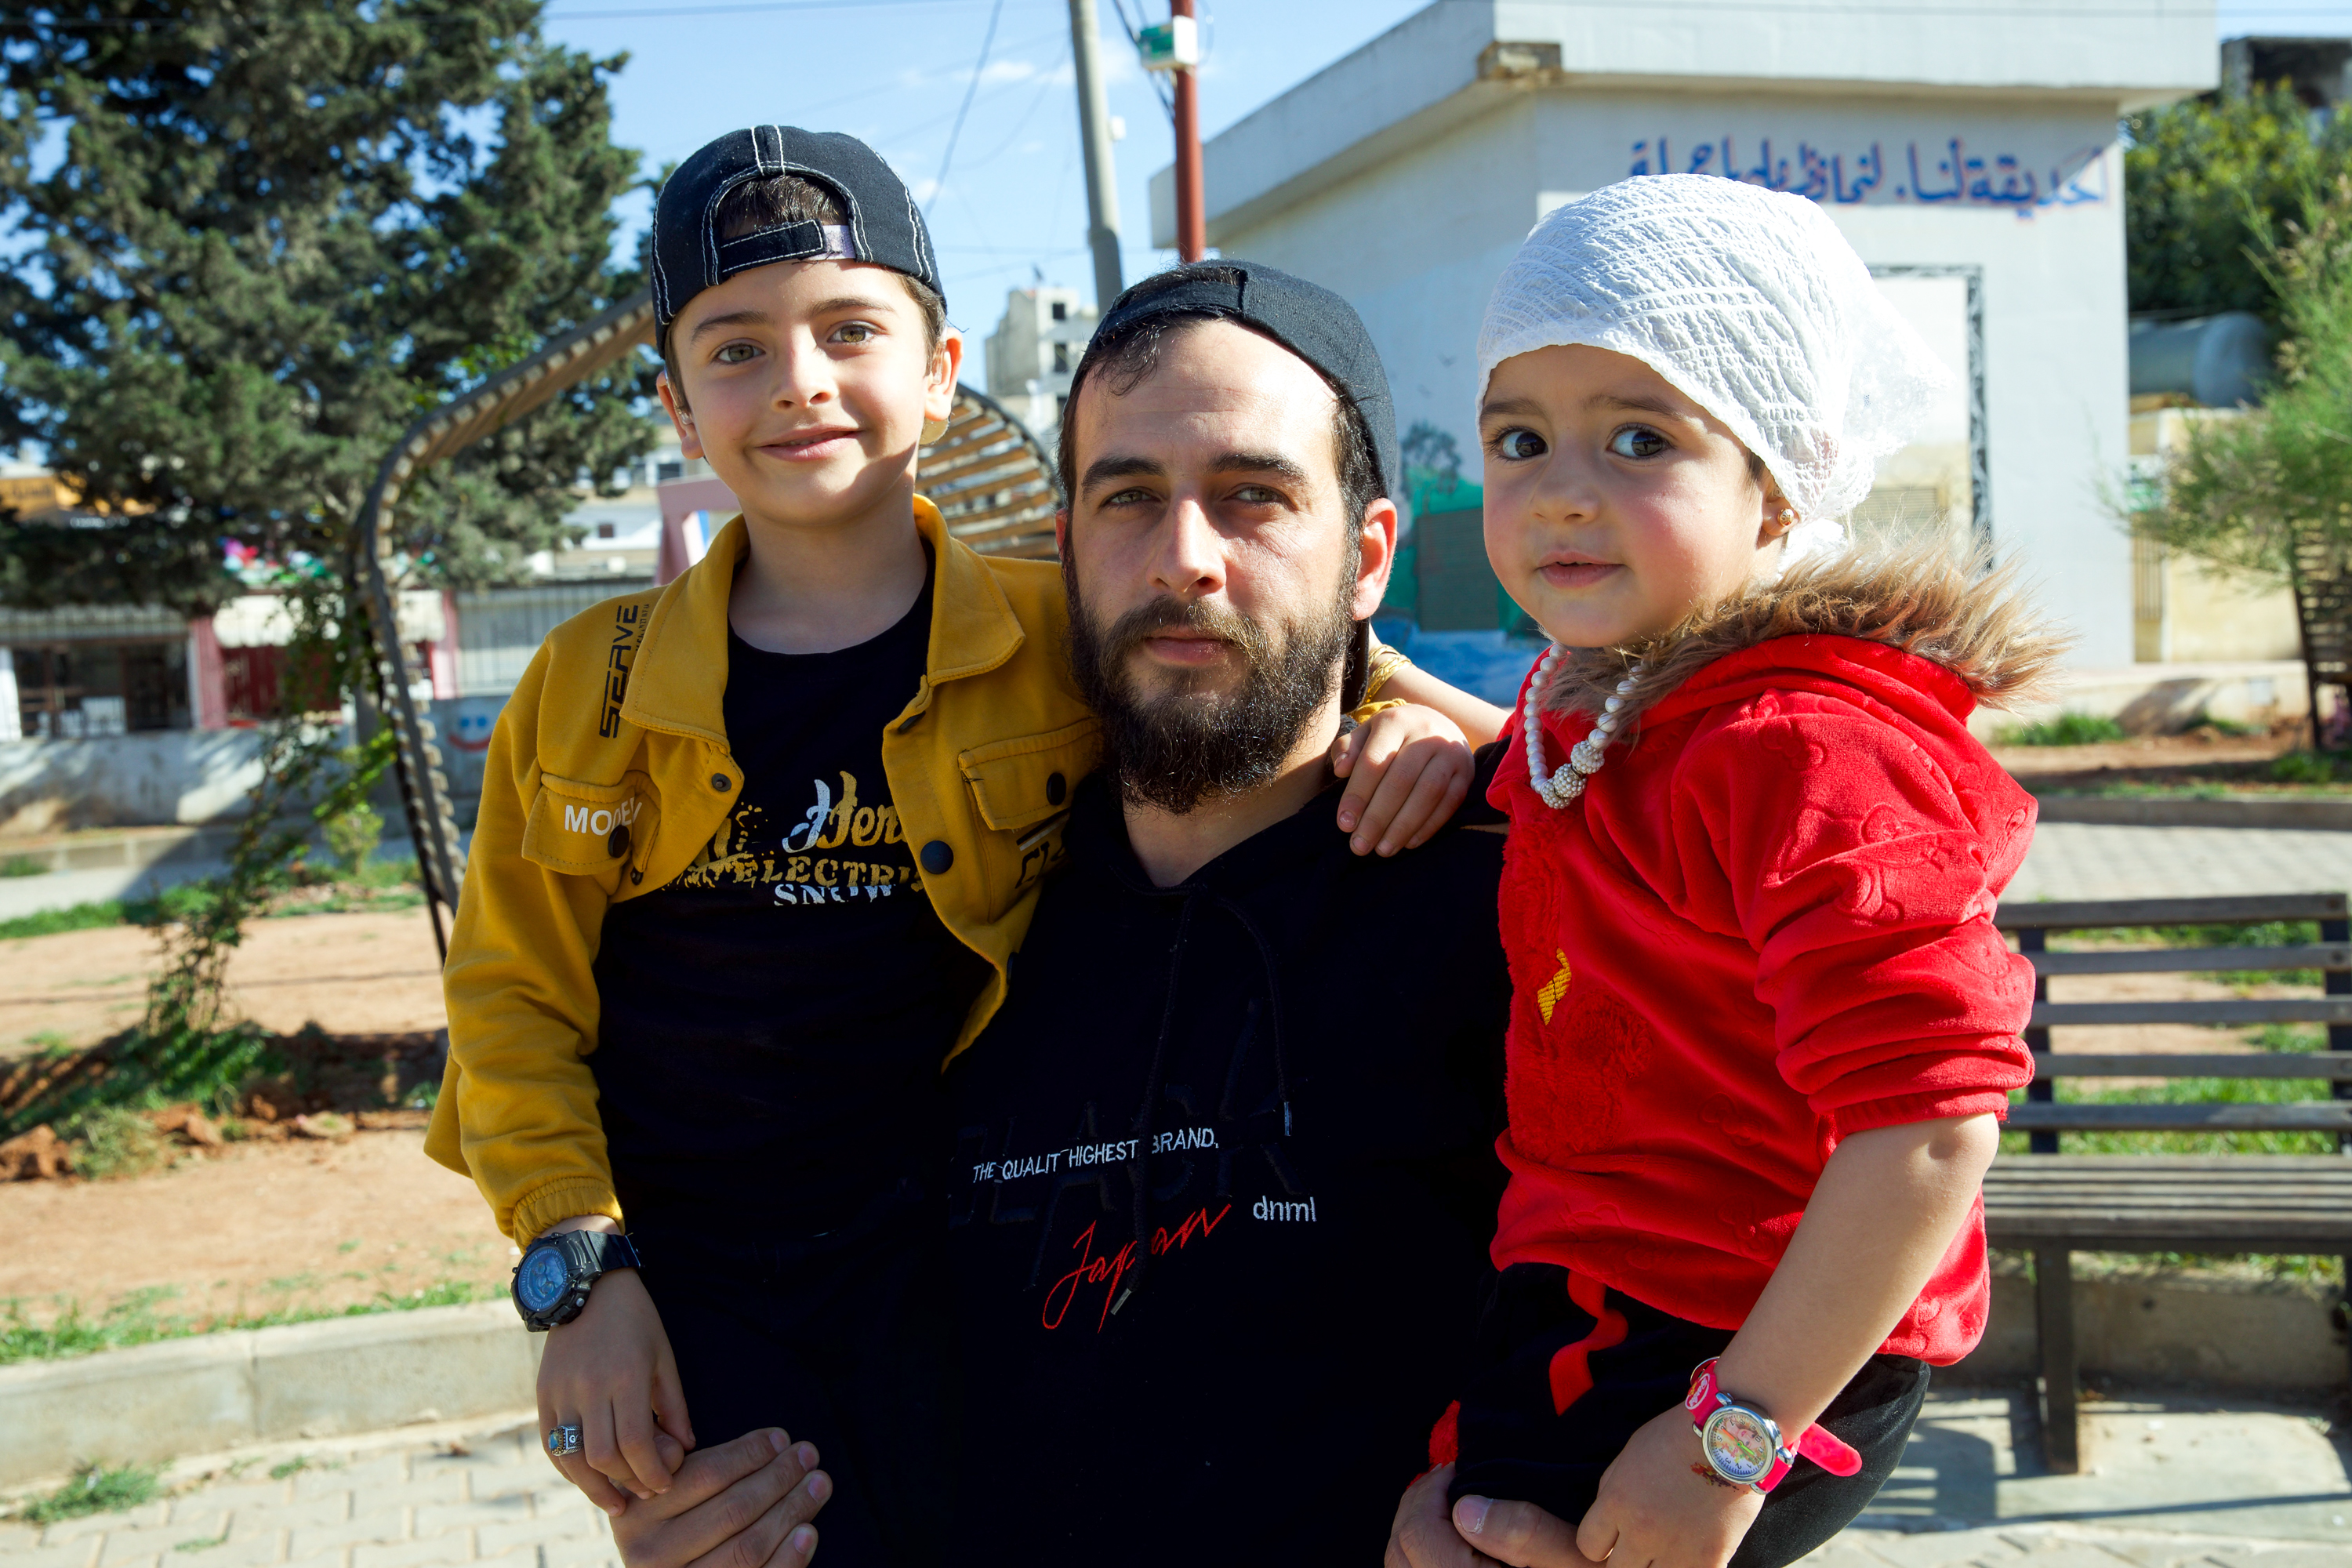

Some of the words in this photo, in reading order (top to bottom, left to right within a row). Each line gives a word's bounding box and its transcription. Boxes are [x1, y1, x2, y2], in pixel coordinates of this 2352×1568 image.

[599, 604, 639, 739] SERVE
[973, 1161, 997, 1184] THE
[1002, 1152, 1061, 1181] QUALIT
[1069, 1139, 1138, 1168] HIGHEST
[1042, 1203, 1232, 1334] Japan
